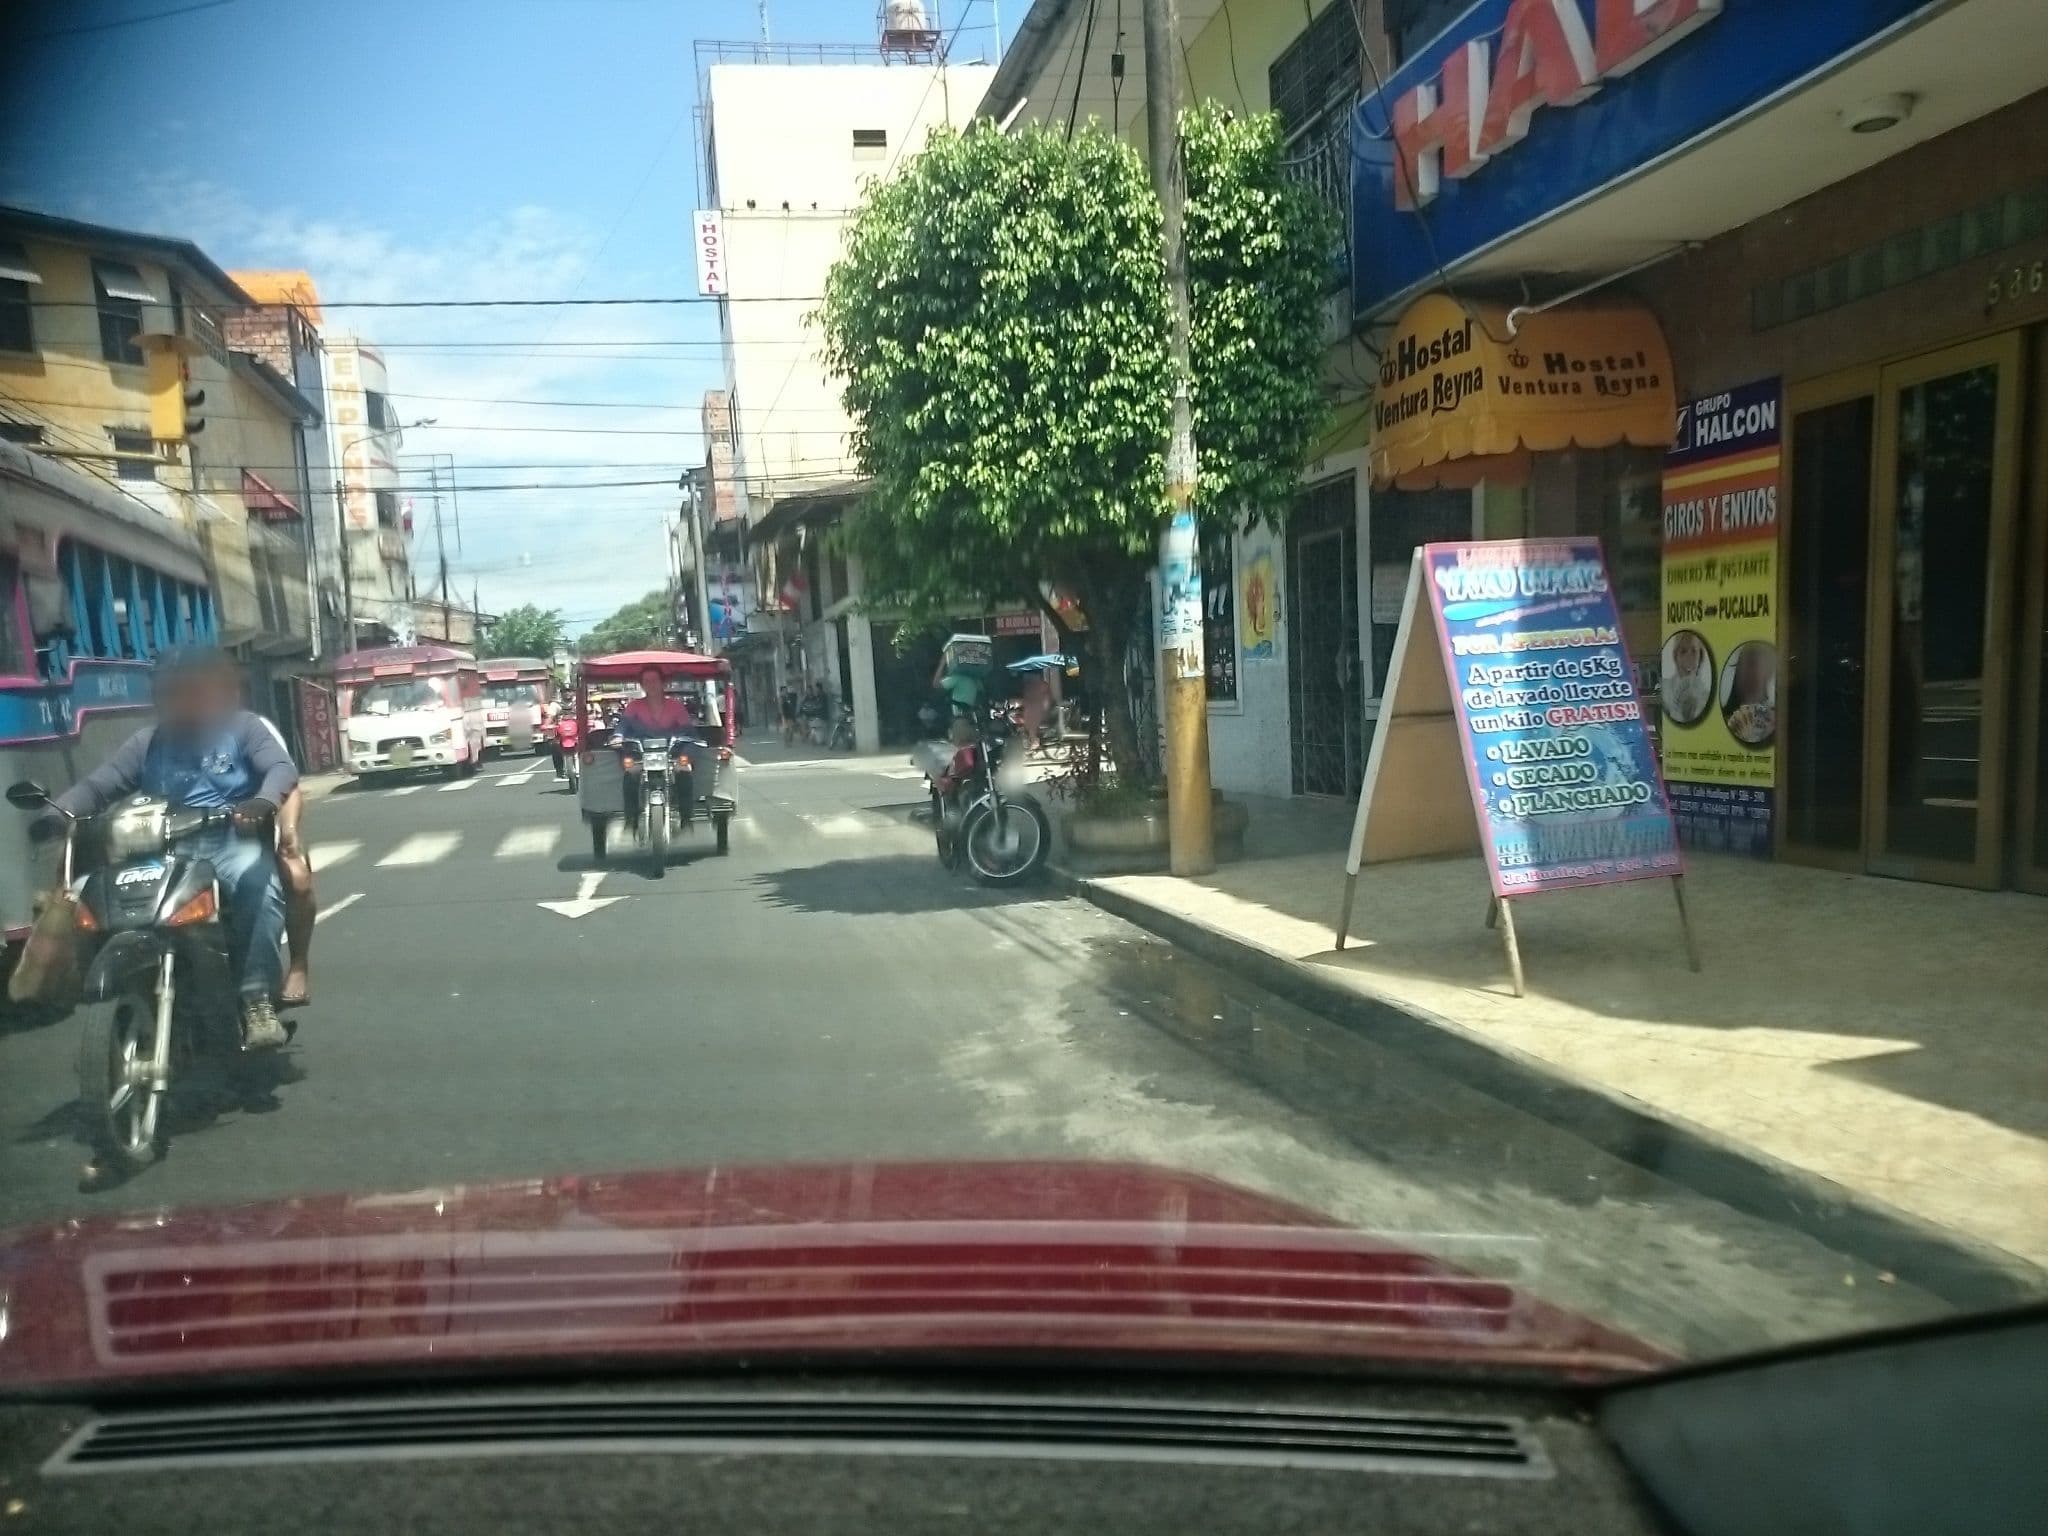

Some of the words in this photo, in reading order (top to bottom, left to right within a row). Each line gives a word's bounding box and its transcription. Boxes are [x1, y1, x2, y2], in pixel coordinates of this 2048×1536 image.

[702, 223, 720, 295] HOSTAL
[1398, 318, 1472, 382] Hostal
[1542, 351, 1647, 376] Hostal
[1374, 385, 1429, 433] Ventura
[1431, 365, 1484, 417] Reyna
[1498, 374, 1582, 395] Ventura
[1595, 374, 1660, 397] Reyna
[1695, 392, 1731, 416] GRUPO
[1695, 399, 1776, 448] HALCON
[1664, 499, 1704, 543] GIROS
[1707, 496, 1717, 533] Y
[1720, 485, 1777, 531] ENVIOS
[1667, 600, 1703, 626] IQUITOS
[1719, 593, 1769, 620] PUCALLPA
[1471, 666, 1486, 682] A
[1493, 662, 1549, 684] partir
[1554, 660, 1577, 676] de
[1581, 657, 1621, 677] 5Kg
[1471, 692, 1493, 706] de
[1498, 685, 1561, 705] lavado
[1563, 680, 1631, 700] llevate
[1475, 717, 1498, 730] un
[1505, 711, 1543, 728] kilo
[1547, 702, 1639, 726] GRATIS!!
[1503, 736, 1591, 762] LAVADO
[1510, 762, 1597, 786] SECADO
[1516, 782, 1650, 813] PLANCHADO
